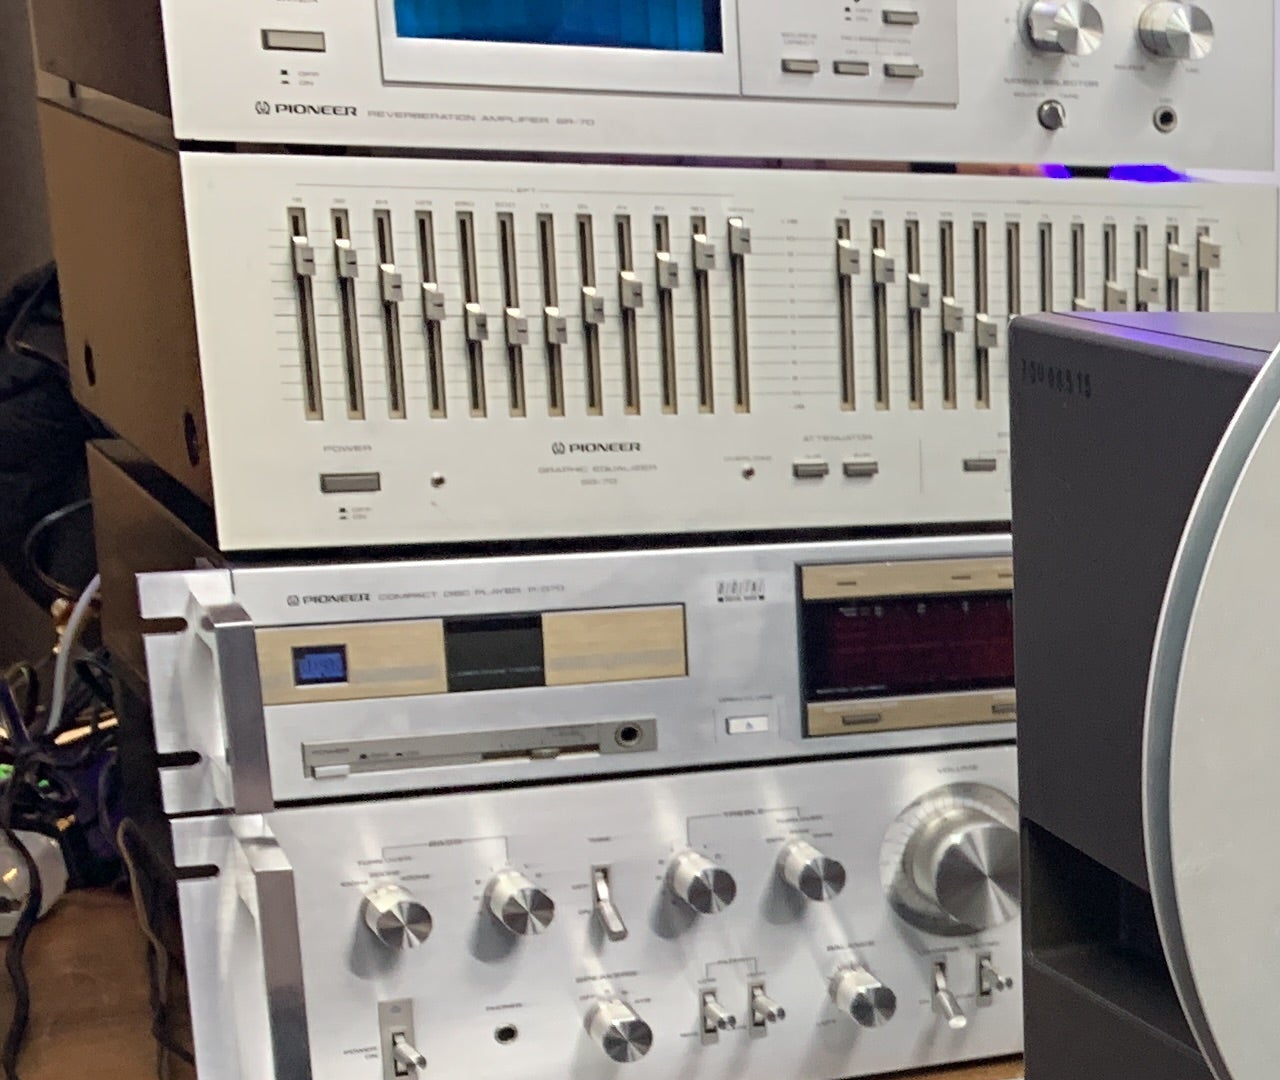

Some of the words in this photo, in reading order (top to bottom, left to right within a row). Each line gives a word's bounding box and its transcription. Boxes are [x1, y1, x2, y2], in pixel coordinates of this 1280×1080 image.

[274, 103, 358, 117] PIONEER
[568, 441, 642, 453] PIONEER
[302, 592, 371, 605] PIONEER
